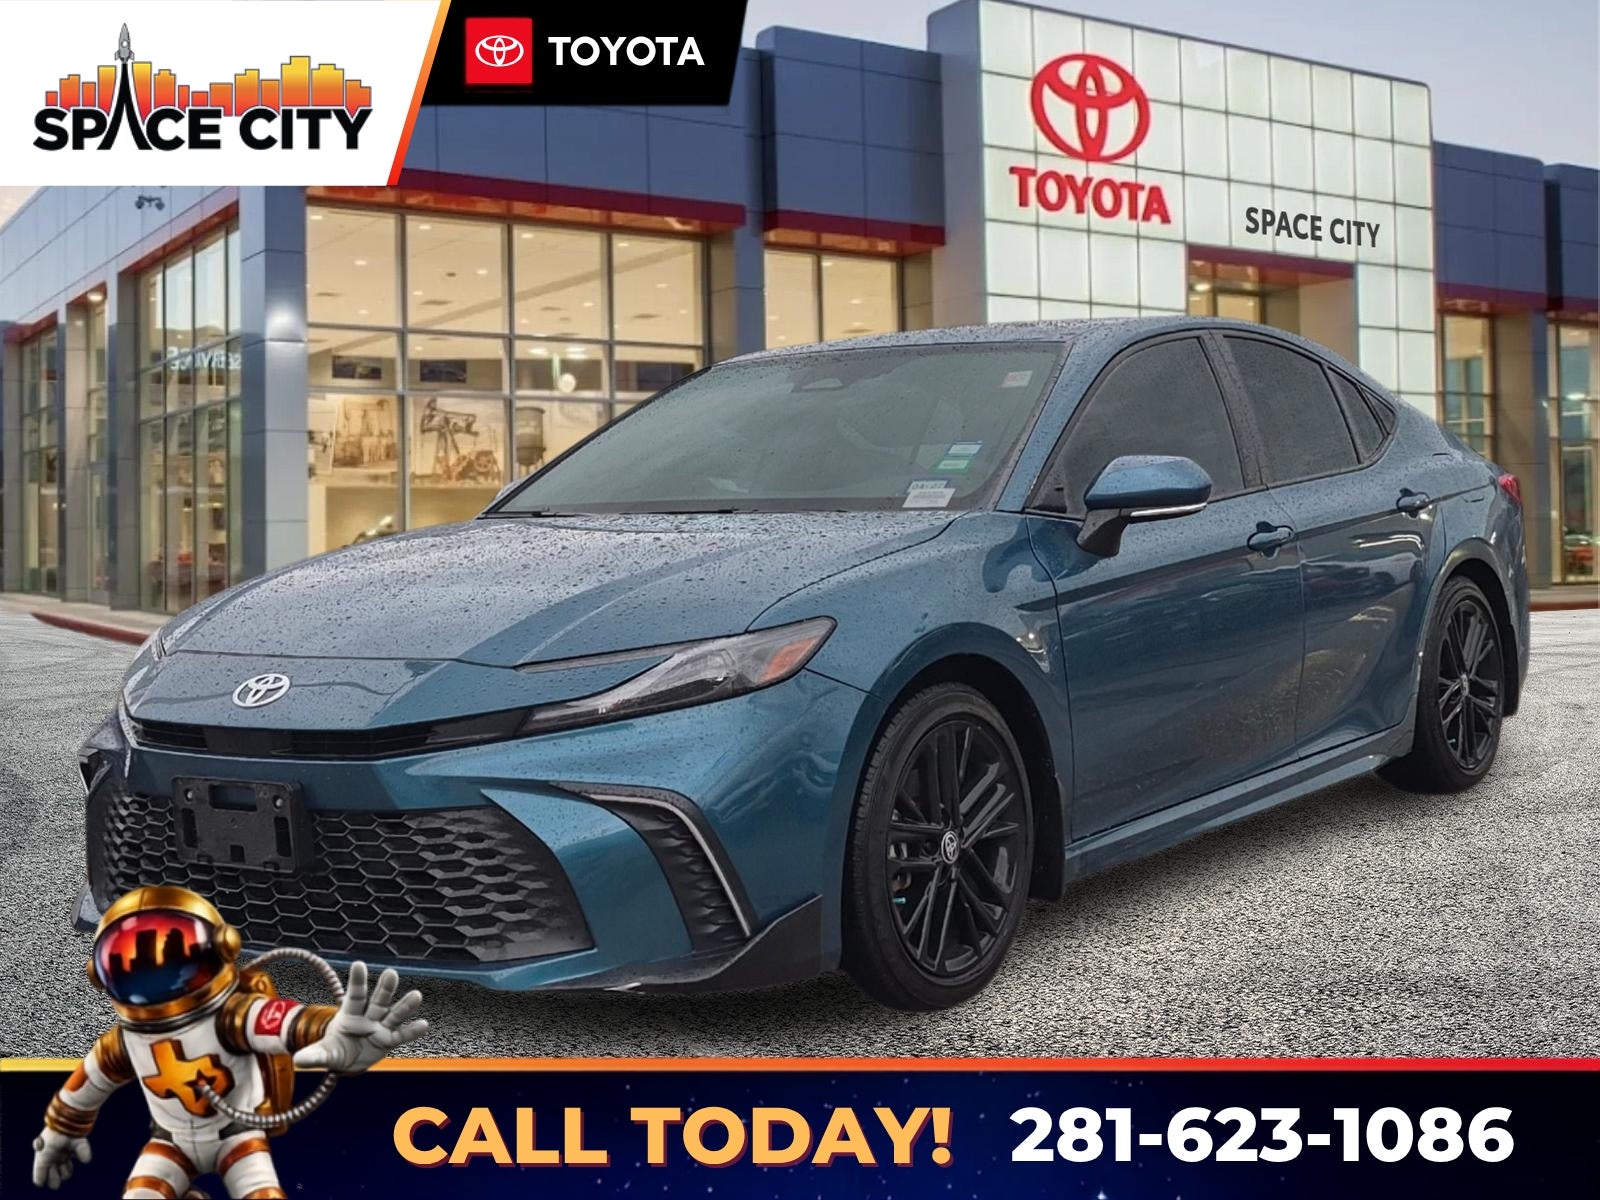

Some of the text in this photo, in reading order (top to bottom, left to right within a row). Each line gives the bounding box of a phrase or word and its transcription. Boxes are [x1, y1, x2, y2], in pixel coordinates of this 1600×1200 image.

[1008, 165, 1172, 225] TOYOTA
[1245, 206, 1381, 249] SPACE CITY
